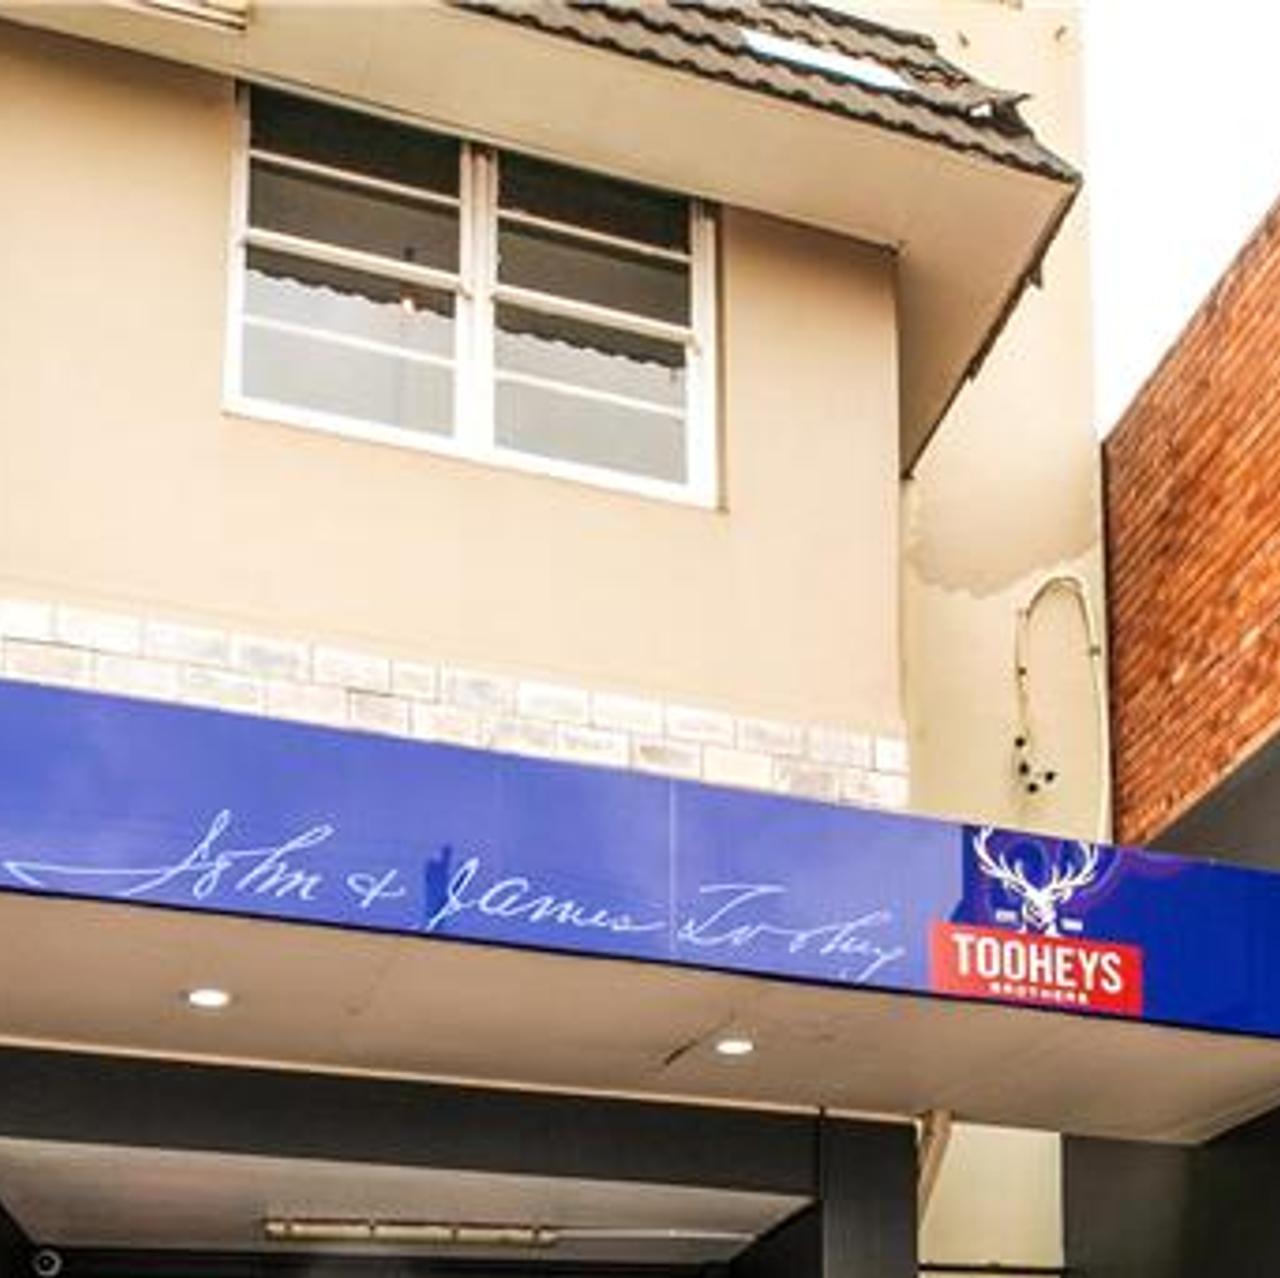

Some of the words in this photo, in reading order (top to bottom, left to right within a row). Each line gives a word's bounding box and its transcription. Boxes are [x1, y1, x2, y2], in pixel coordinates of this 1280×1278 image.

[3, 809, 334, 901] John
[427, 858, 666, 931] James
[951, 932, 1123, 995] TOOHEYS
